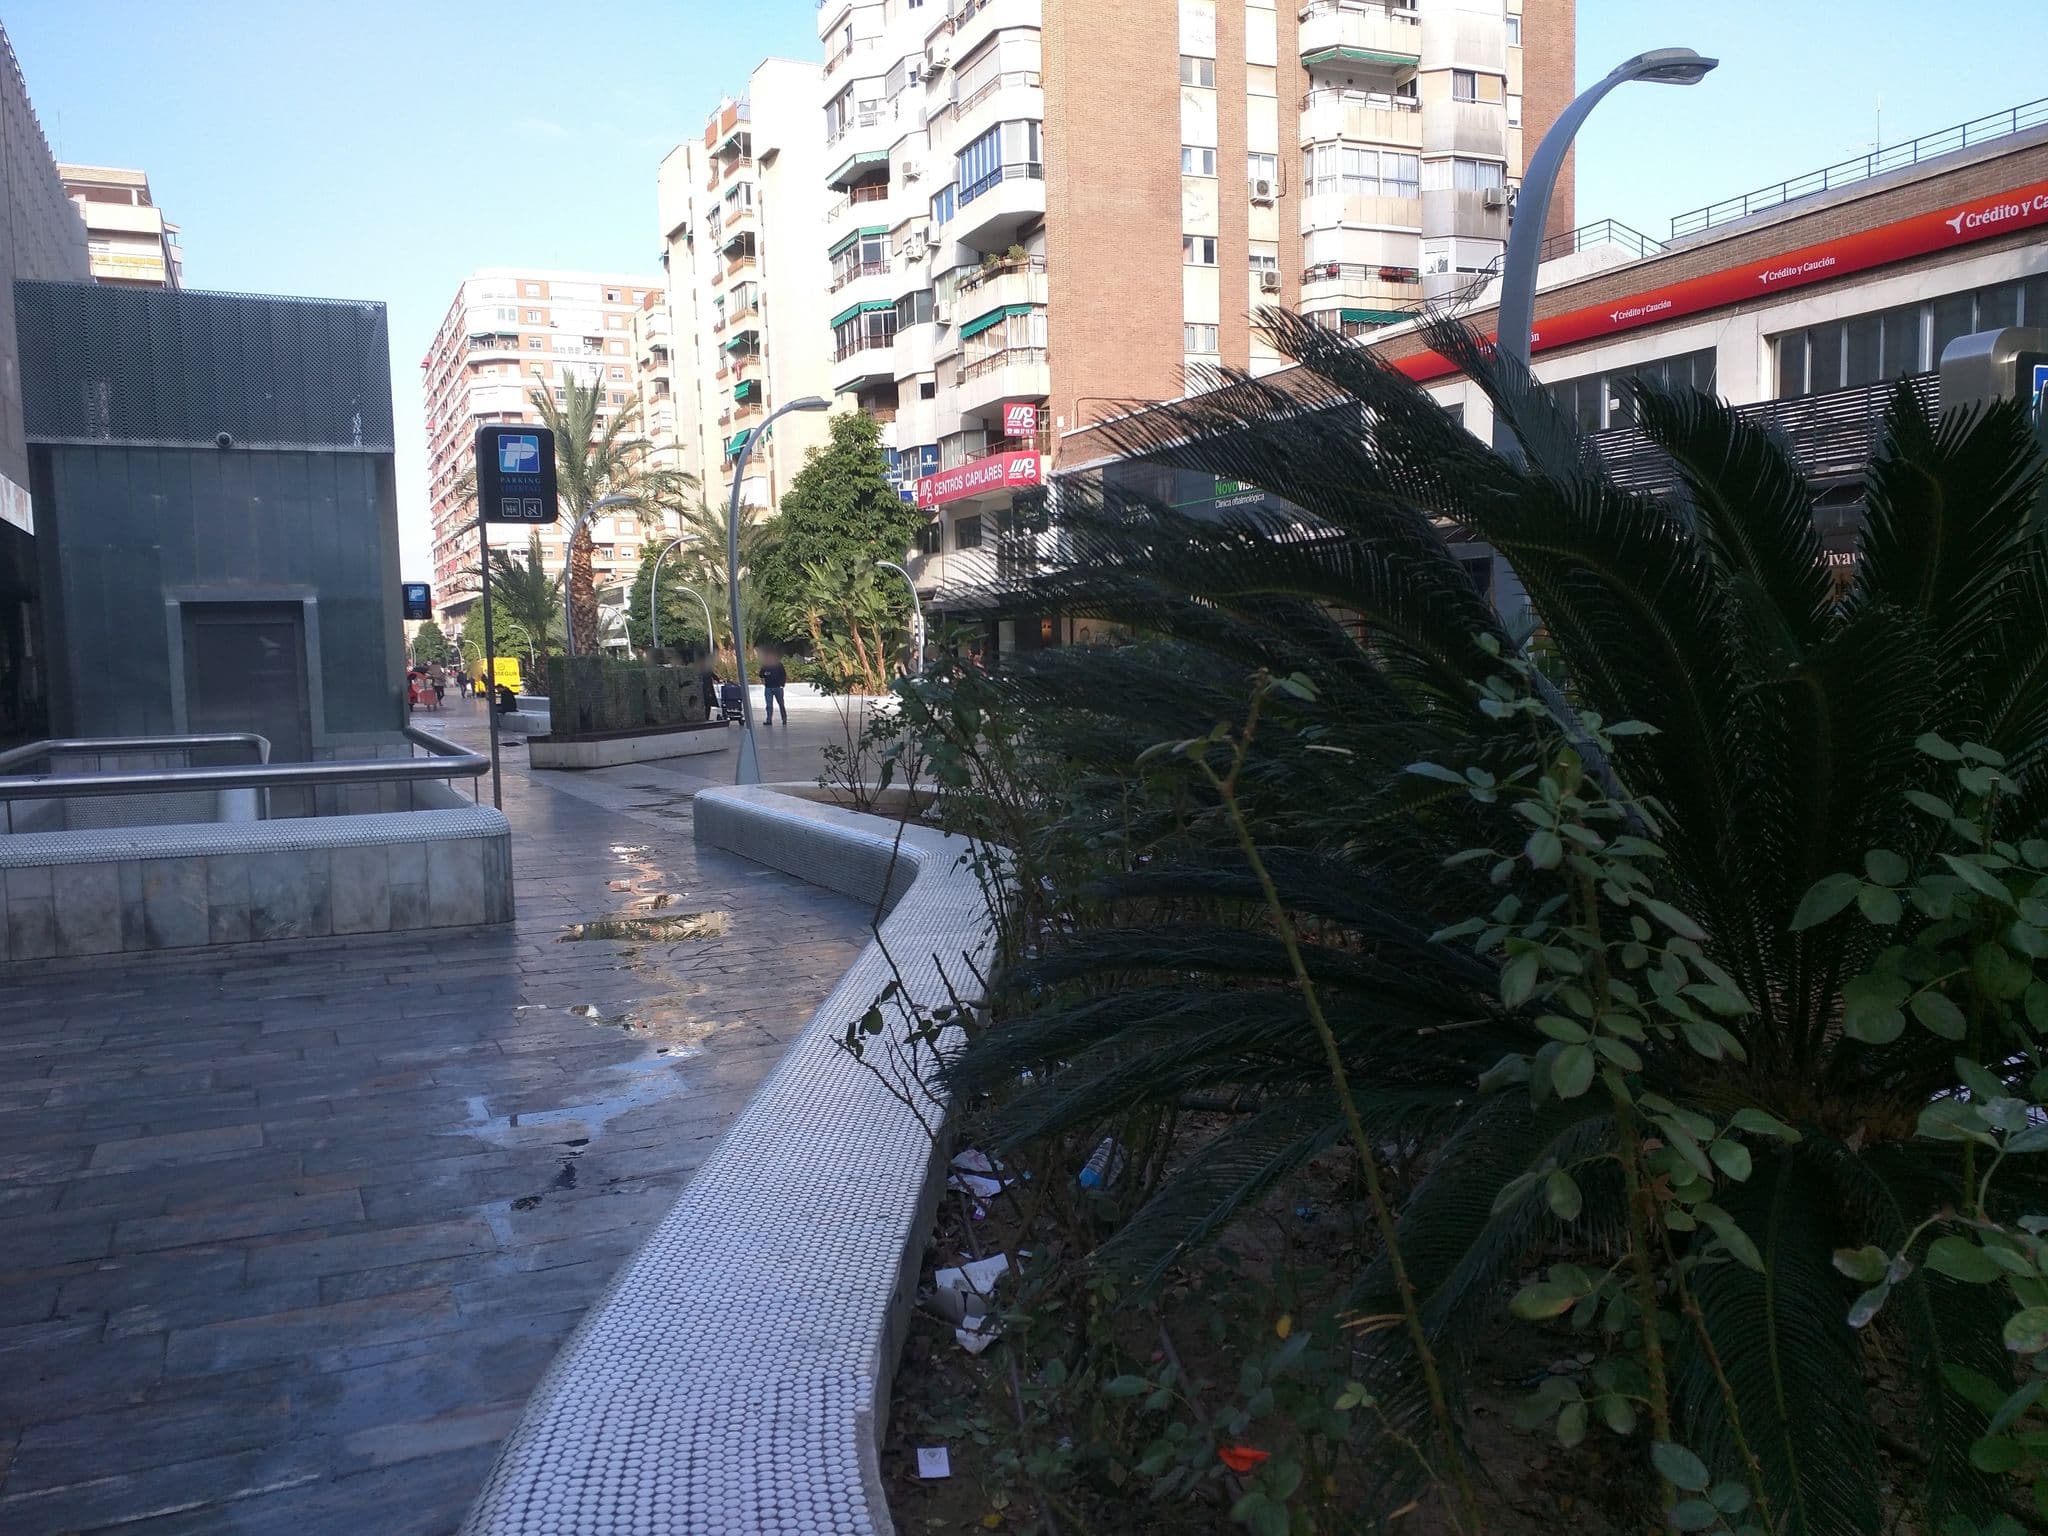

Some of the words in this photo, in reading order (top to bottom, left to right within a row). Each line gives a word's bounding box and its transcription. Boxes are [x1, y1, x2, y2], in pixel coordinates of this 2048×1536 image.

[1965, 204, 2020, 228] Crédito
[2020, 200, 2032, 216] y
[1769, 267, 1797, 281] Crédito
[1803, 256, 1836, 272] Caución
[1645, 299, 1672, 313] Caución
[500, 477, 541, 485] PARKING
[934, 476, 964, 497] CENTROS
[965, 463, 1003, 488] CAPILARES
